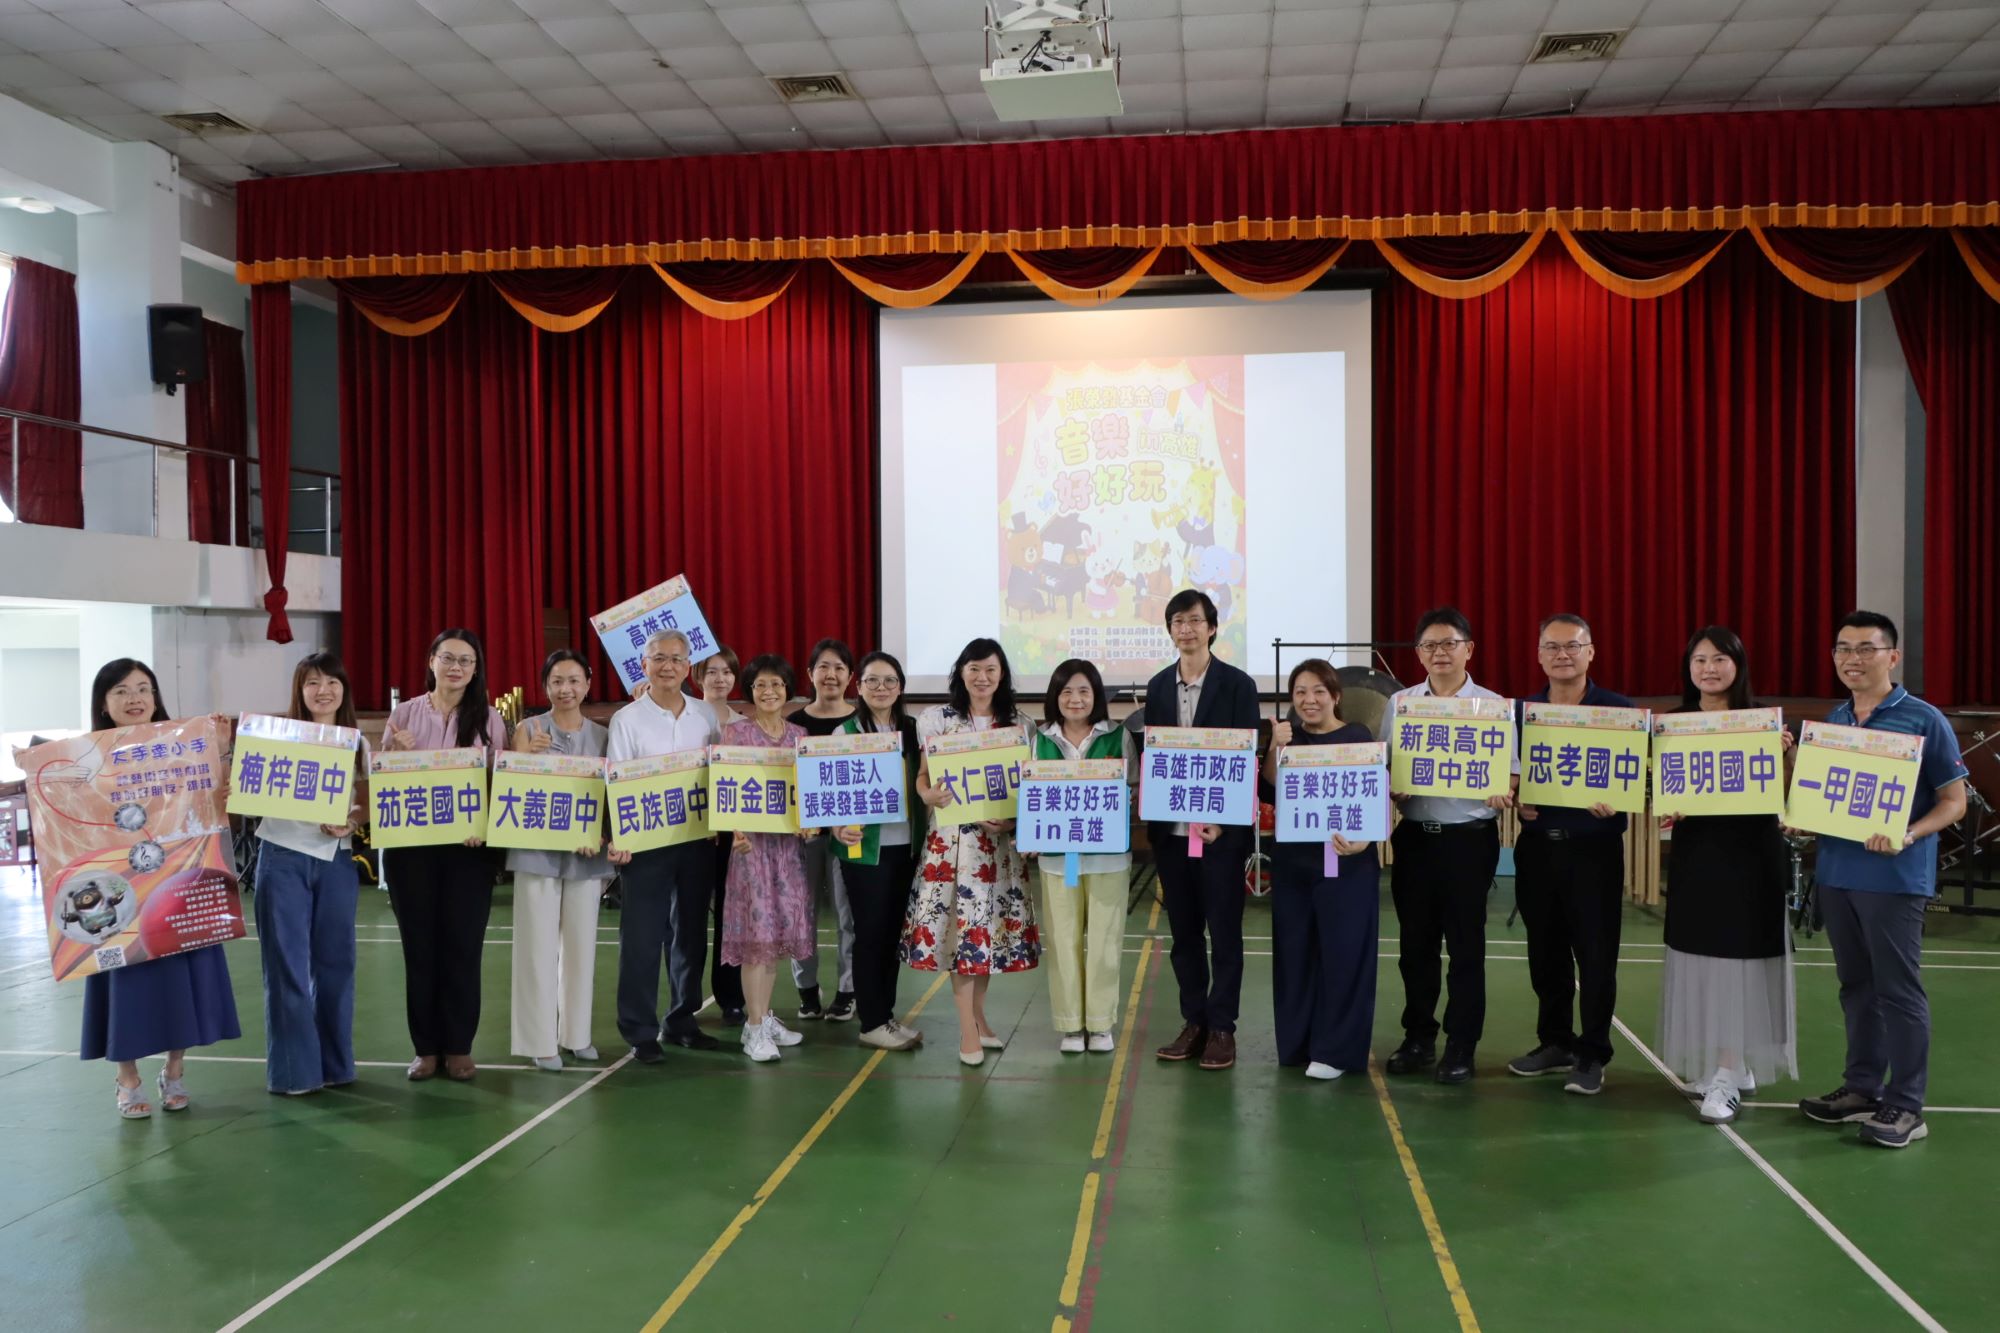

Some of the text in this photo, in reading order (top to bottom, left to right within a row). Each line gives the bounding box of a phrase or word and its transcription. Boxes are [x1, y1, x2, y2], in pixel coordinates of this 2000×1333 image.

[1066, 385, 1168, 411] 張榮發基金會
[1055, 413, 1129, 466] 音樂
[1053, 460, 1167, 513] 好好玩
[626, 609, 678, 650] 高雄市
[111, 737, 208, 765] 大手牽小手
[1400, 722, 1505, 756] 新興高中
[238, 751, 346, 805] 楠梓國中
[819, 758, 882, 787] 財團法人
[1152, 752, 1247, 783] 高雄市政府
[1284, 770, 1378, 800] 音樂好好玩
[1411, 757, 1490, 790] 國中部
[1528, 741, 1640, 792] 忠孝國中
[1660, 747, 1776, 796] 陽明國中
[377, 782, 481, 829] 茄萣國中
[496, 787, 598, 833] 大義國中
[616, 782, 709, 836] 民族國中
[716, 776, 796, 815] 前金國
[804, 787, 900, 819] 張榮發基金會
[1026, 785, 1119, 812] 音樂好好玩
[1169, 785, 1225, 814] 教育局
[1798, 766, 1906, 824] 一甲國中
